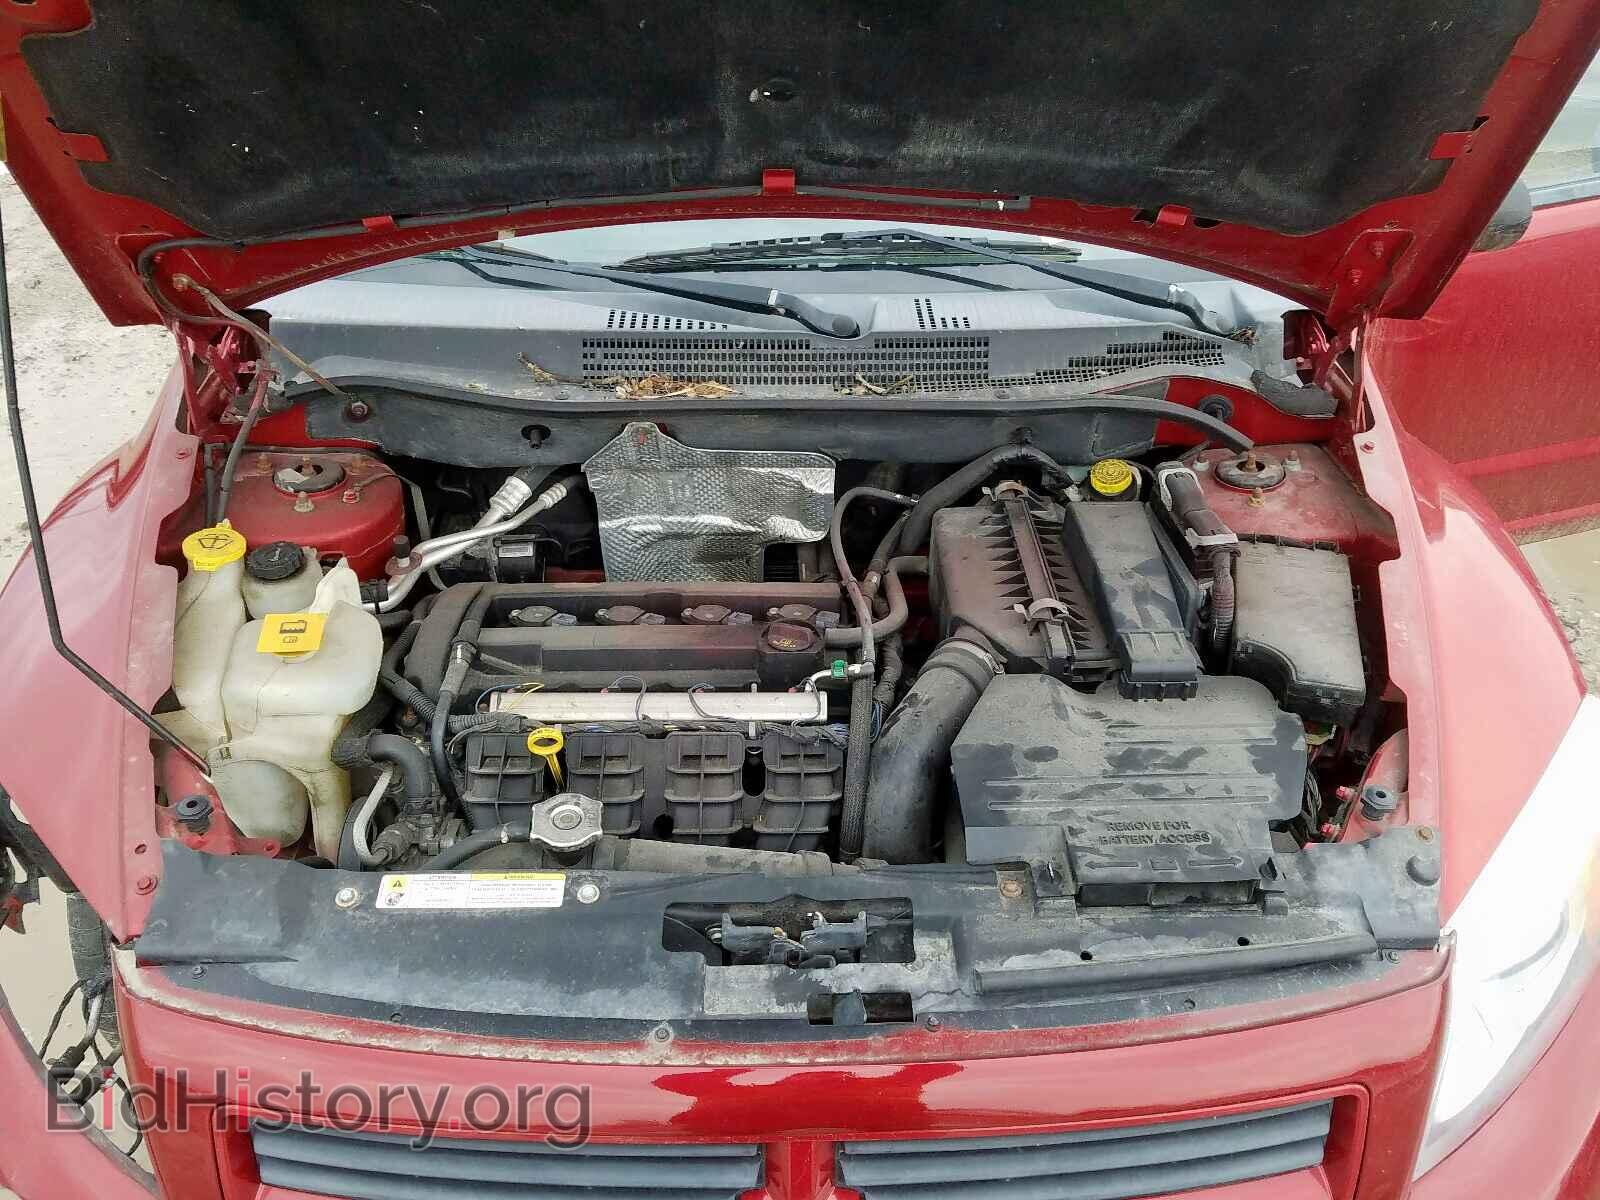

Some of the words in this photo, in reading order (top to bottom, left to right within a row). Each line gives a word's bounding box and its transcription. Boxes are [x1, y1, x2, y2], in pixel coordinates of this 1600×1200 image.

[1106, 821, 1161, 832] REMOVE
[1163, 821, 1191, 831] FOR
[1098, 835, 1154, 846] BATTERY
[1158, 832, 1211, 844] ACCESS
